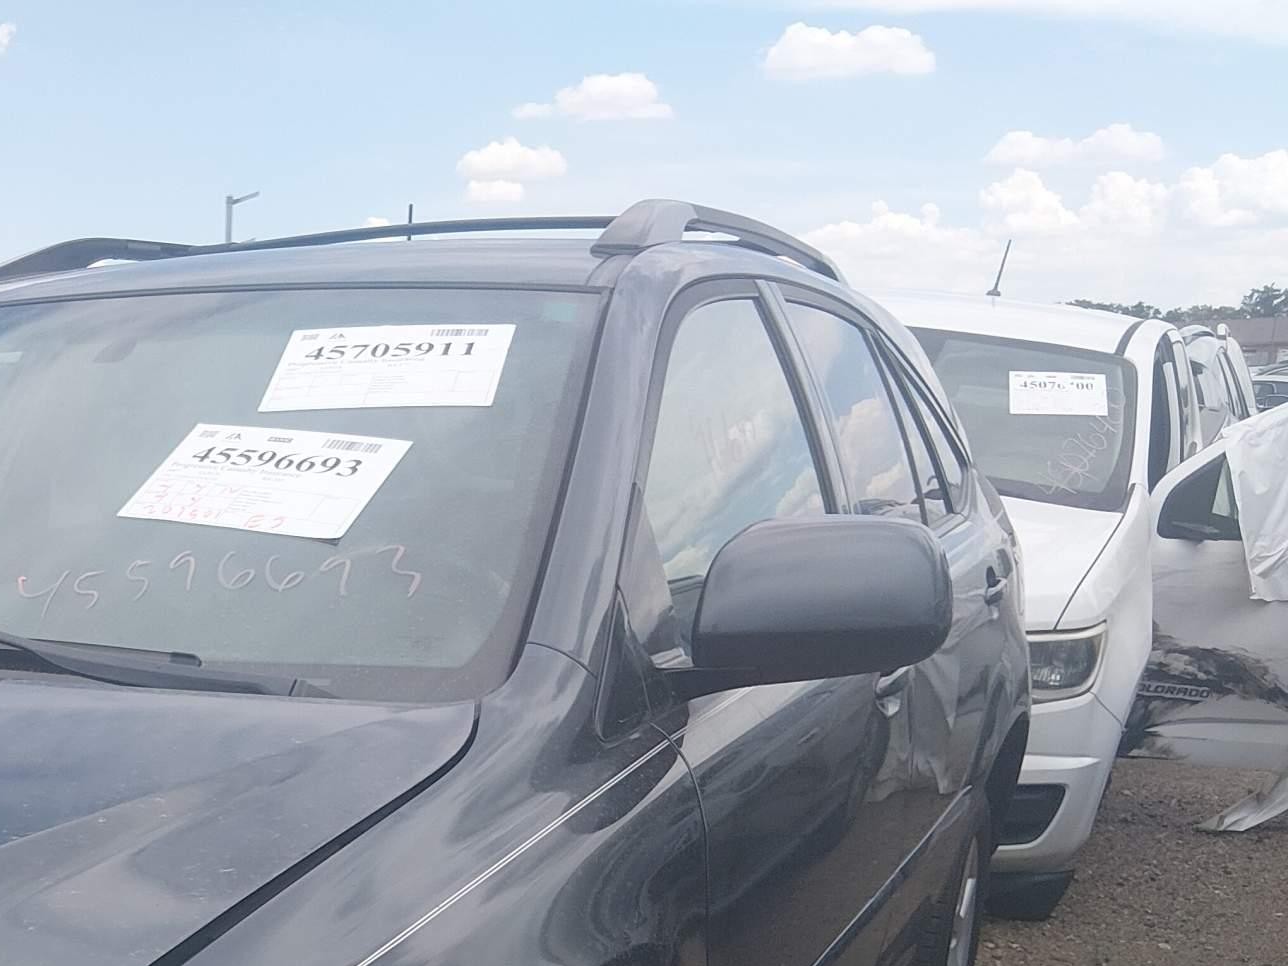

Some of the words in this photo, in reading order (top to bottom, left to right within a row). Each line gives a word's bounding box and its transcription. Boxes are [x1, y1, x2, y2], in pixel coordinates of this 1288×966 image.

[304, 341, 476, 361] 45705911
[191, 446, 364, 479] 45596693
[17, 545, 423, 619] 45596693
